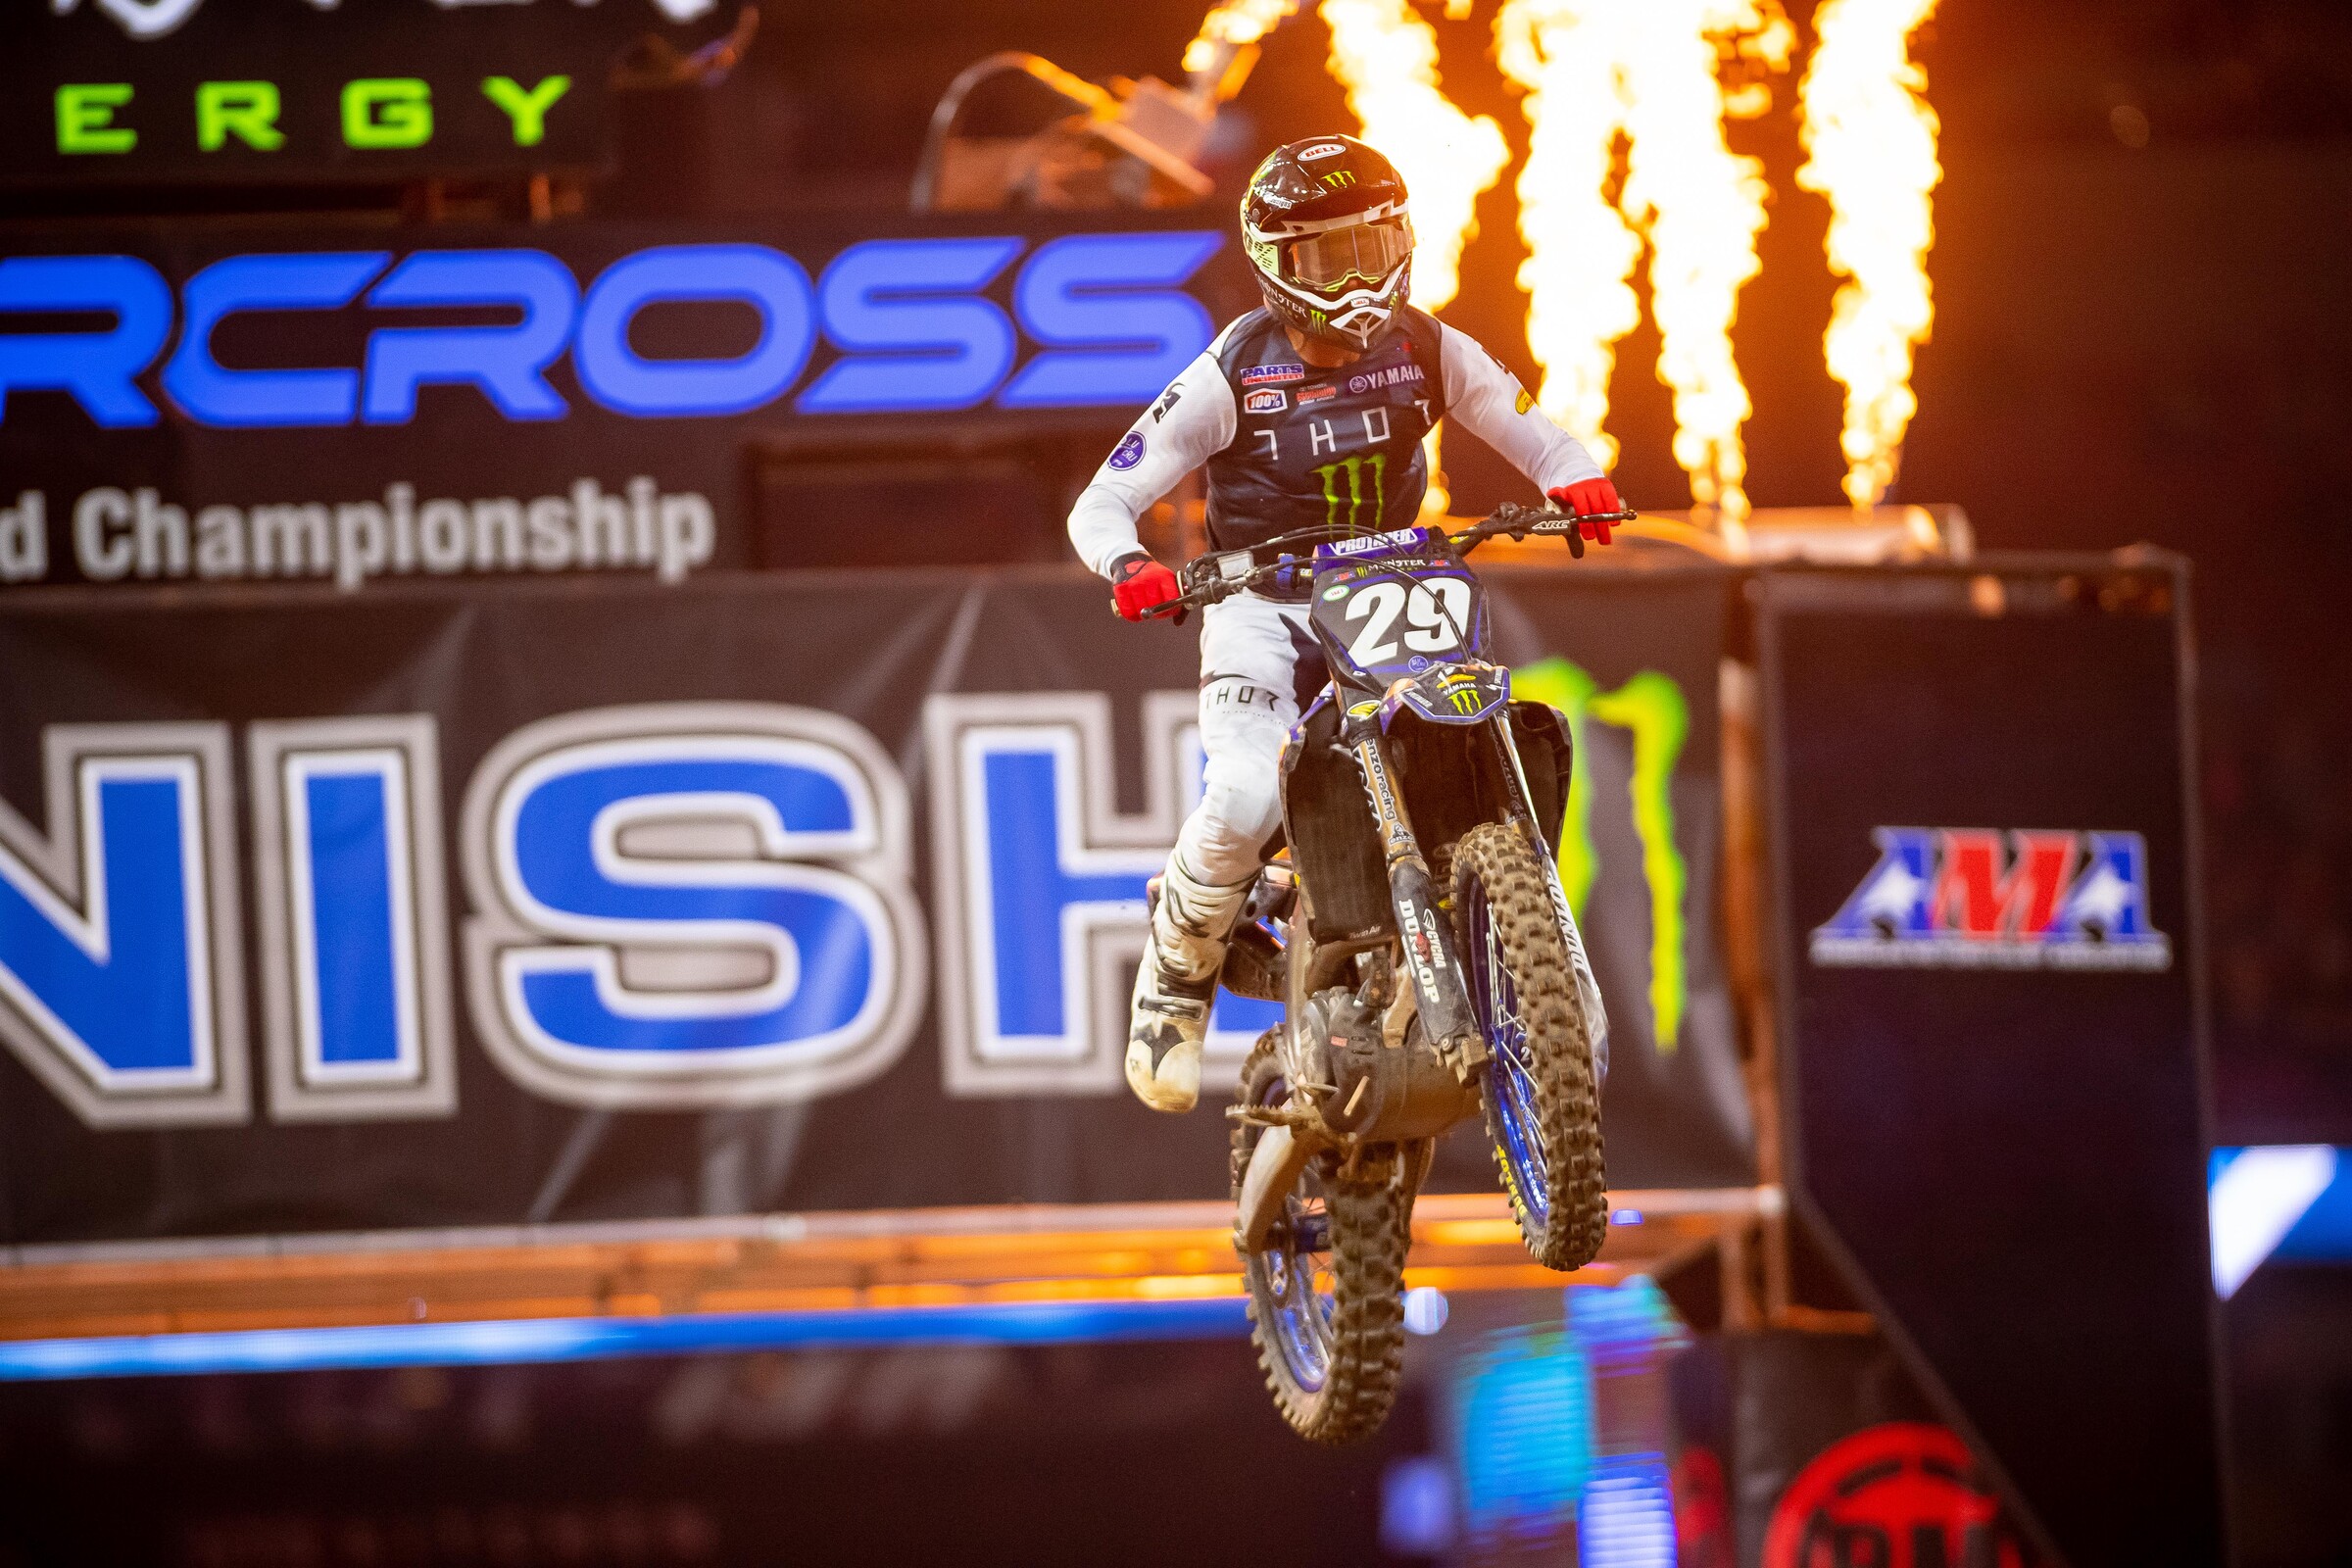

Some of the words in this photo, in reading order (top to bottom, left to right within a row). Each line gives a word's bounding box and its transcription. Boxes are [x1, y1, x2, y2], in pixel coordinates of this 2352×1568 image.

[53, 74, 571, 154] ERGY
[1305, 147, 1336, 157] BELL
[0, 229, 1225, 428] RCROSS
[1242, 365, 1302, 378] PARTS
[1243, 373, 1303, 385] UNLIMITED
[1250, 393, 1281, 409] 100%
[73, 477, 716, 592] Championship
[1531, 519, 1570, 530] ARC
[1346, 577, 1471, 667] 29
[1819, 826, 2164, 941] AMA
[1426, 930, 1446, 968] CYCRA
